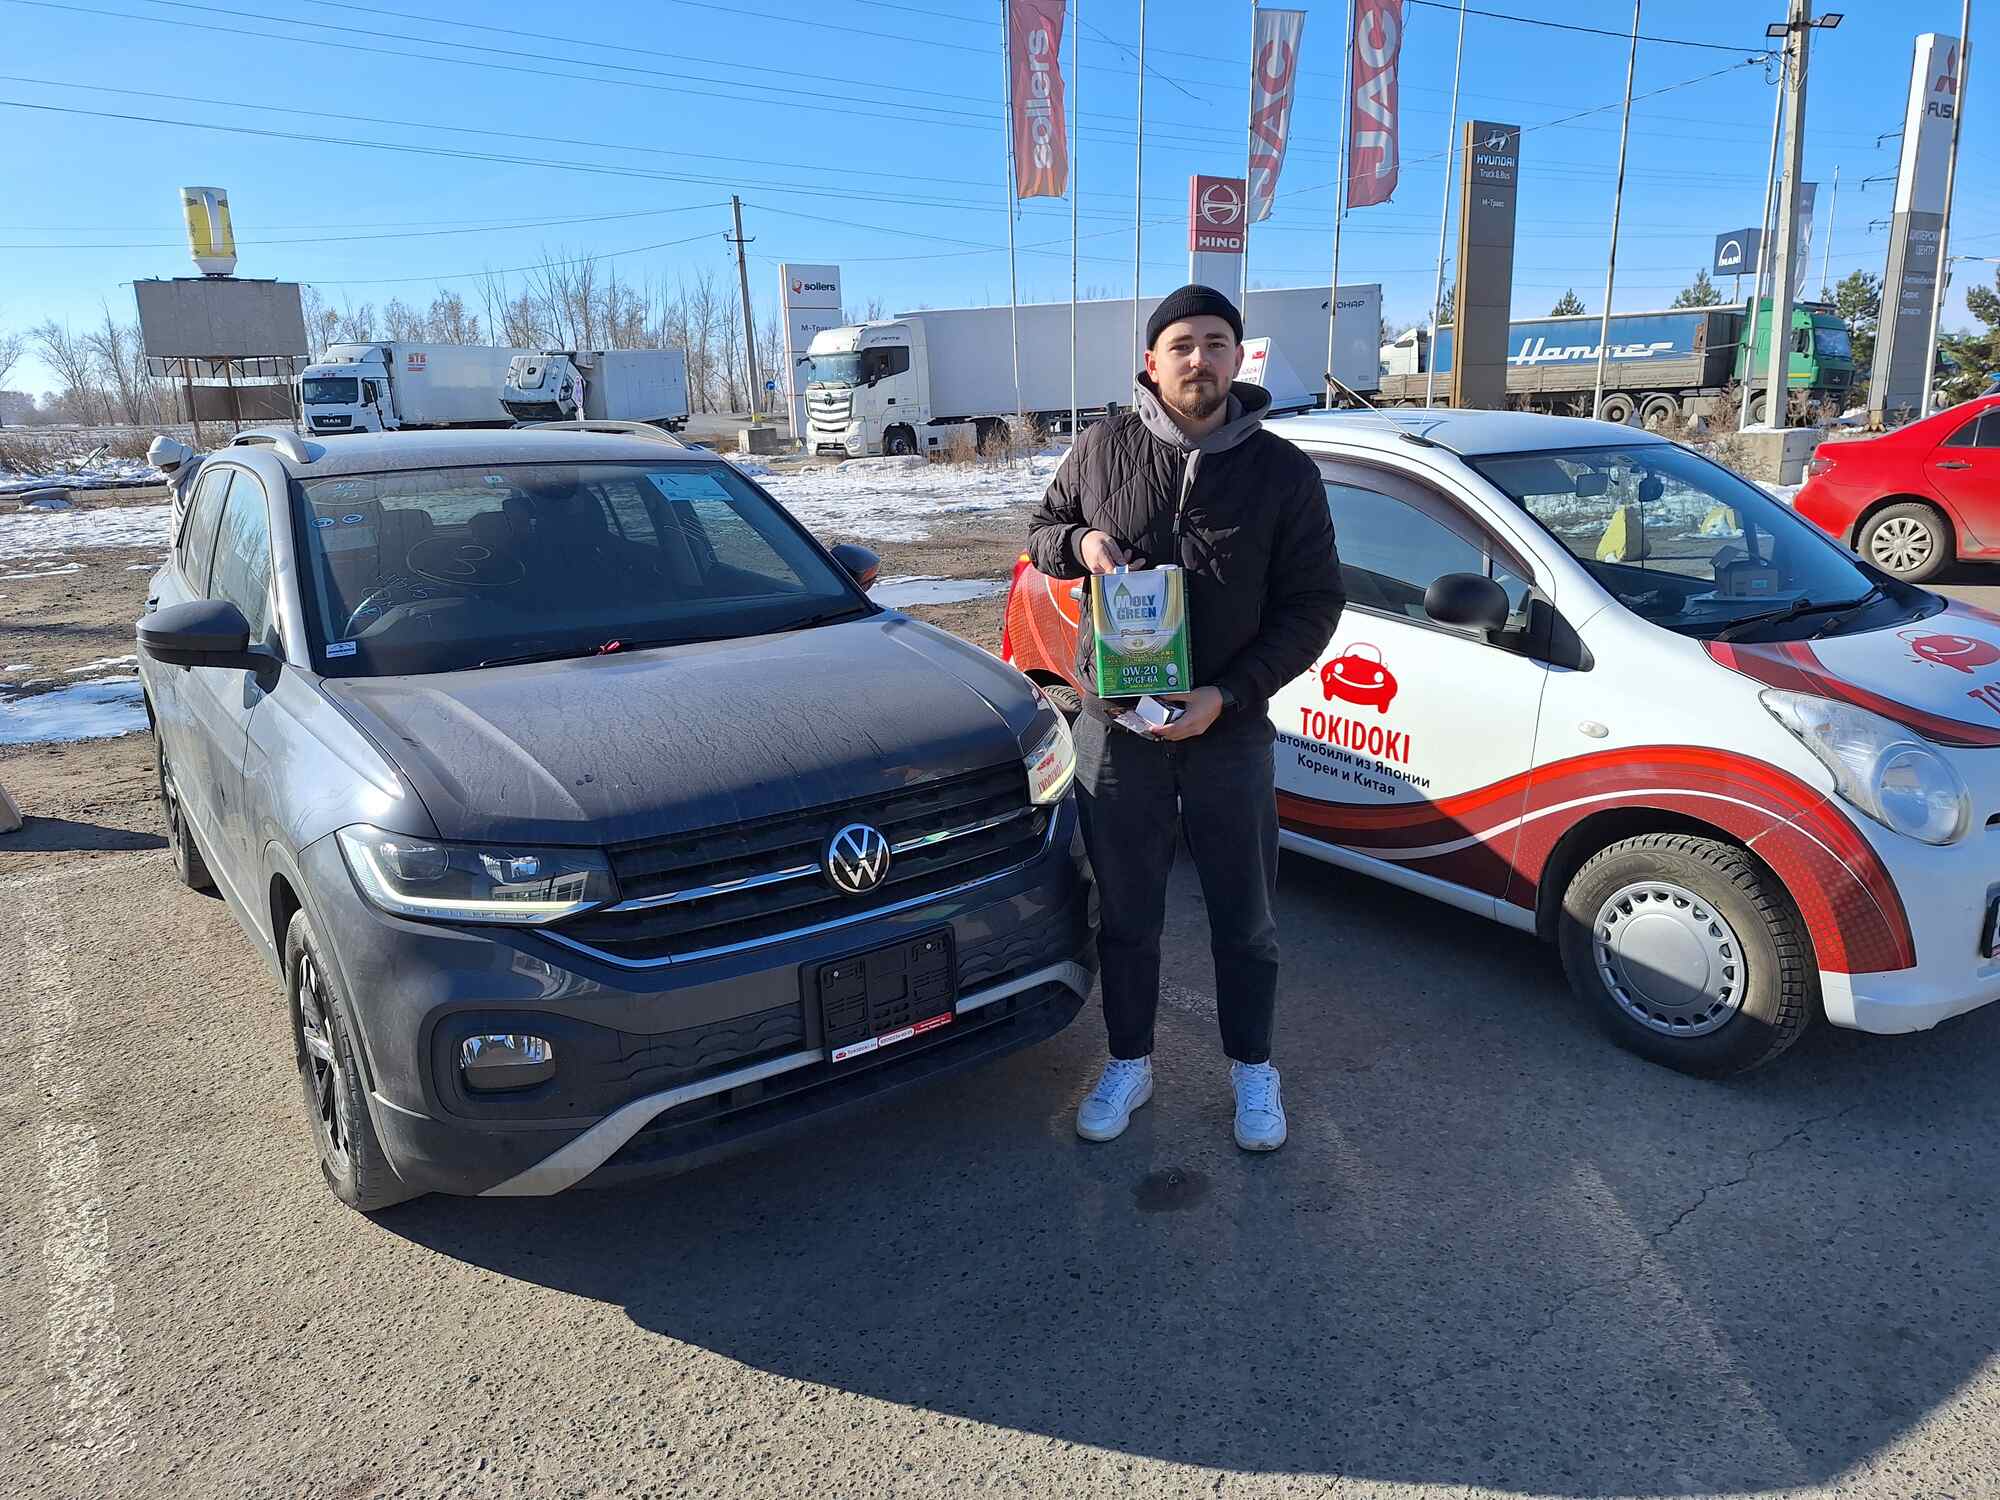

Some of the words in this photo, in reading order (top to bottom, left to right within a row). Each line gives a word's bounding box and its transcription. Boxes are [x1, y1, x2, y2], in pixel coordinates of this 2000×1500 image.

[1024, 29, 1053, 169] sollers
[1357, 10, 1397, 177] JAC
[1249, 40, 1294, 198] JAC
[1928, 102, 1955, 119] FUS
[1476, 153, 1515, 168] HYUNDAI
[1199, 236, 1240, 249] HINO
[804, 281, 836, 292] sollers
[1336, 300, 1365, 310] ОНАР
[1116, 607, 1157, 620] GREEN
[1122, 665, 1158, 677] 0W-20
[1300, 706, 1411, 764] TOKIDOKI
[1297, 753, 1338, 778] Кореи
[1341, 768, 1350, 780] и
[1355, 772, 1396, 796] Китая
[1355, 755, 1371, 770] из
[1375, 760, 1431, 789] Японии
